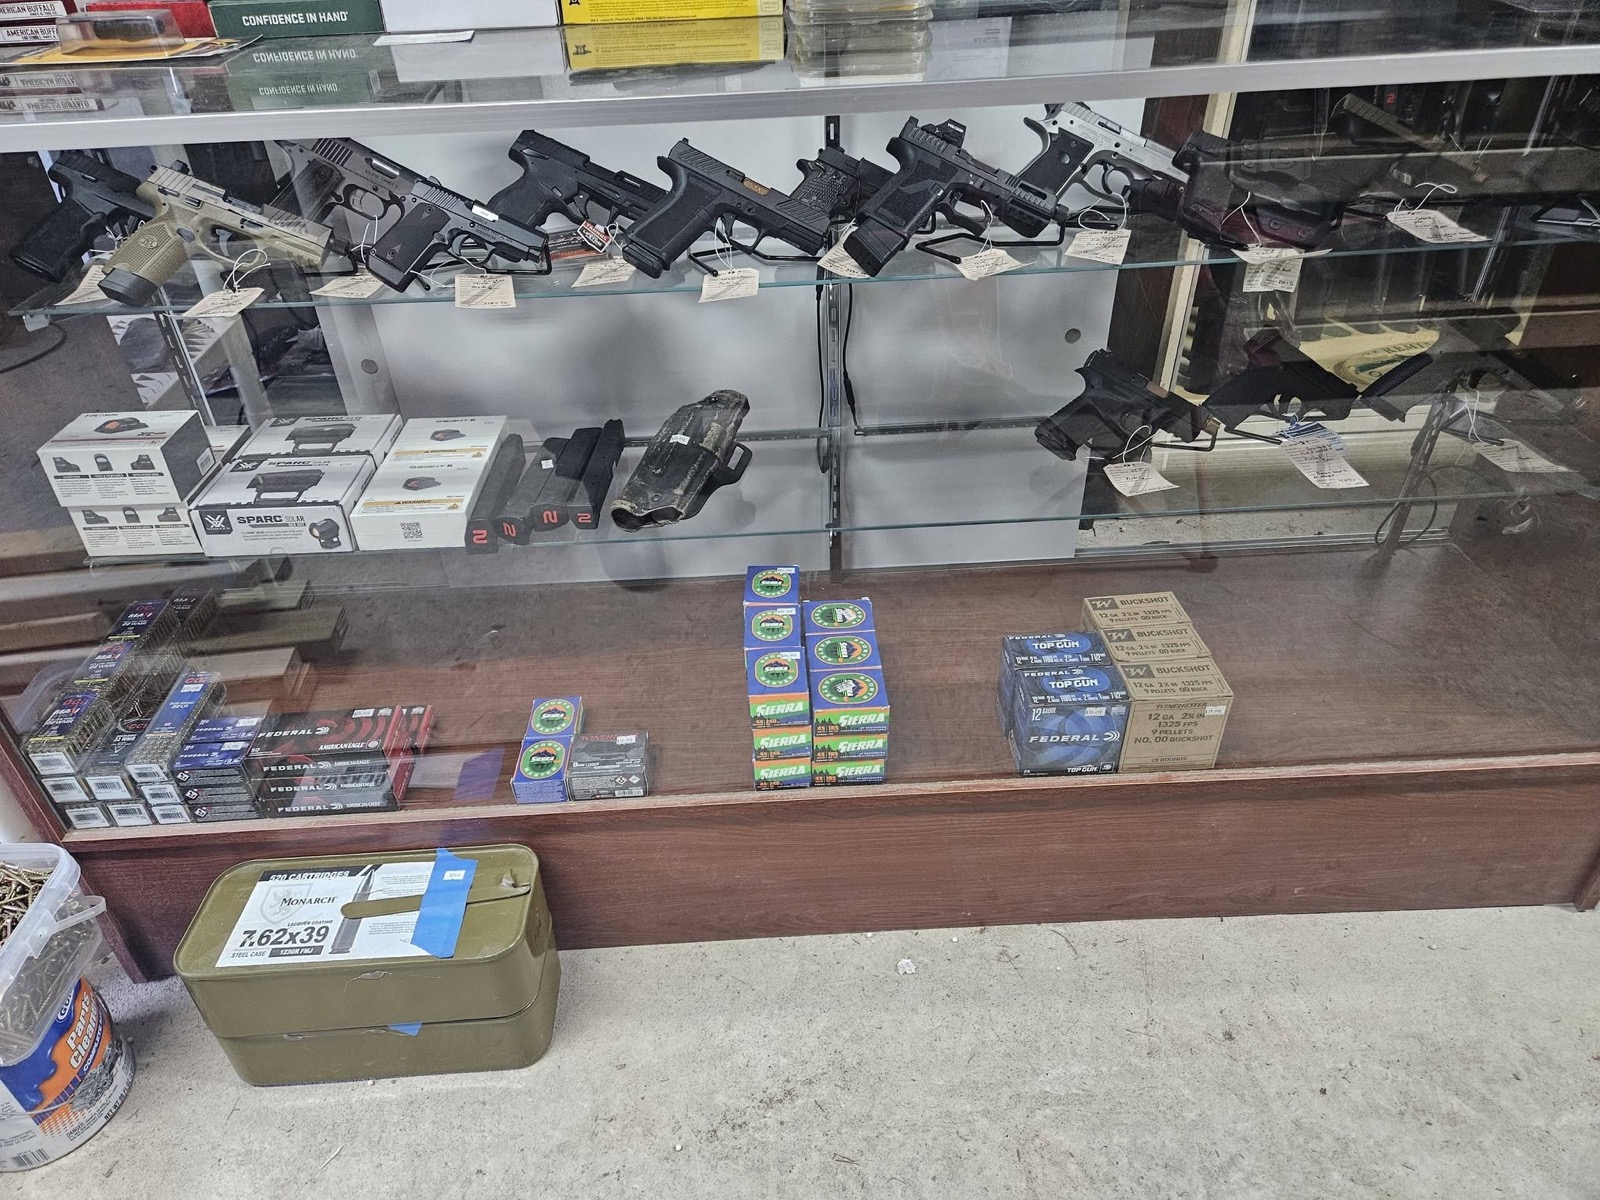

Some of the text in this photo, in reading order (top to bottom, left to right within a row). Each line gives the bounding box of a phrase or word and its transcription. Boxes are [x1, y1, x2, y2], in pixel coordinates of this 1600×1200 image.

[27, 4, 56, 12] BUFFALO
[242, 11, 348, 27] CONFIDENCE IN HAND
[6, 28, 39, 37] AMERICAN
[237, 515, 283, 524] SPARC
[1120, 596, 1169, 606] BUCKSHOT
[1136, 628, 1189, 638] BUCKSHOT
[1156, 664, 1211, 674] BUCKSHOT
[1048, 680, 1099, 689] TOP GUN
[756, 702, 804, 717] SIERRA
[1156, 702, 1208, 710] WINCHESTER
[1032, 708, 1041, 721] 12
[1148, 713, 1161, 721] 12
[838, 713, 885, 728] SIERRA
[258, 729, 313, 738] FEDERAL
[1028, 734, 1100, 743] FEDERAL
[760, 734, 807, 750] SIERRA
[1134, 736, 1152, 744] NO.
[1170, 734, 1214, 743] BUCKSHOT
[838, 739, 884, 753] SIERRA
[263, 764, 316, 772] FEDERAL
[760, 765, 806, 780] SIERRA
[836, 765, 881, 778] SIERRA
[270, 785, 323, 793] FEDERAL
[278, 805, 329, 813] FEDERAL
[288, 871, 350, 881] CARTRIDGES
[280, 896, 336, 907] MONARCH
[240, 926, 330, 948] 7.62x39
[66, 991, 90, 1051] Parts
